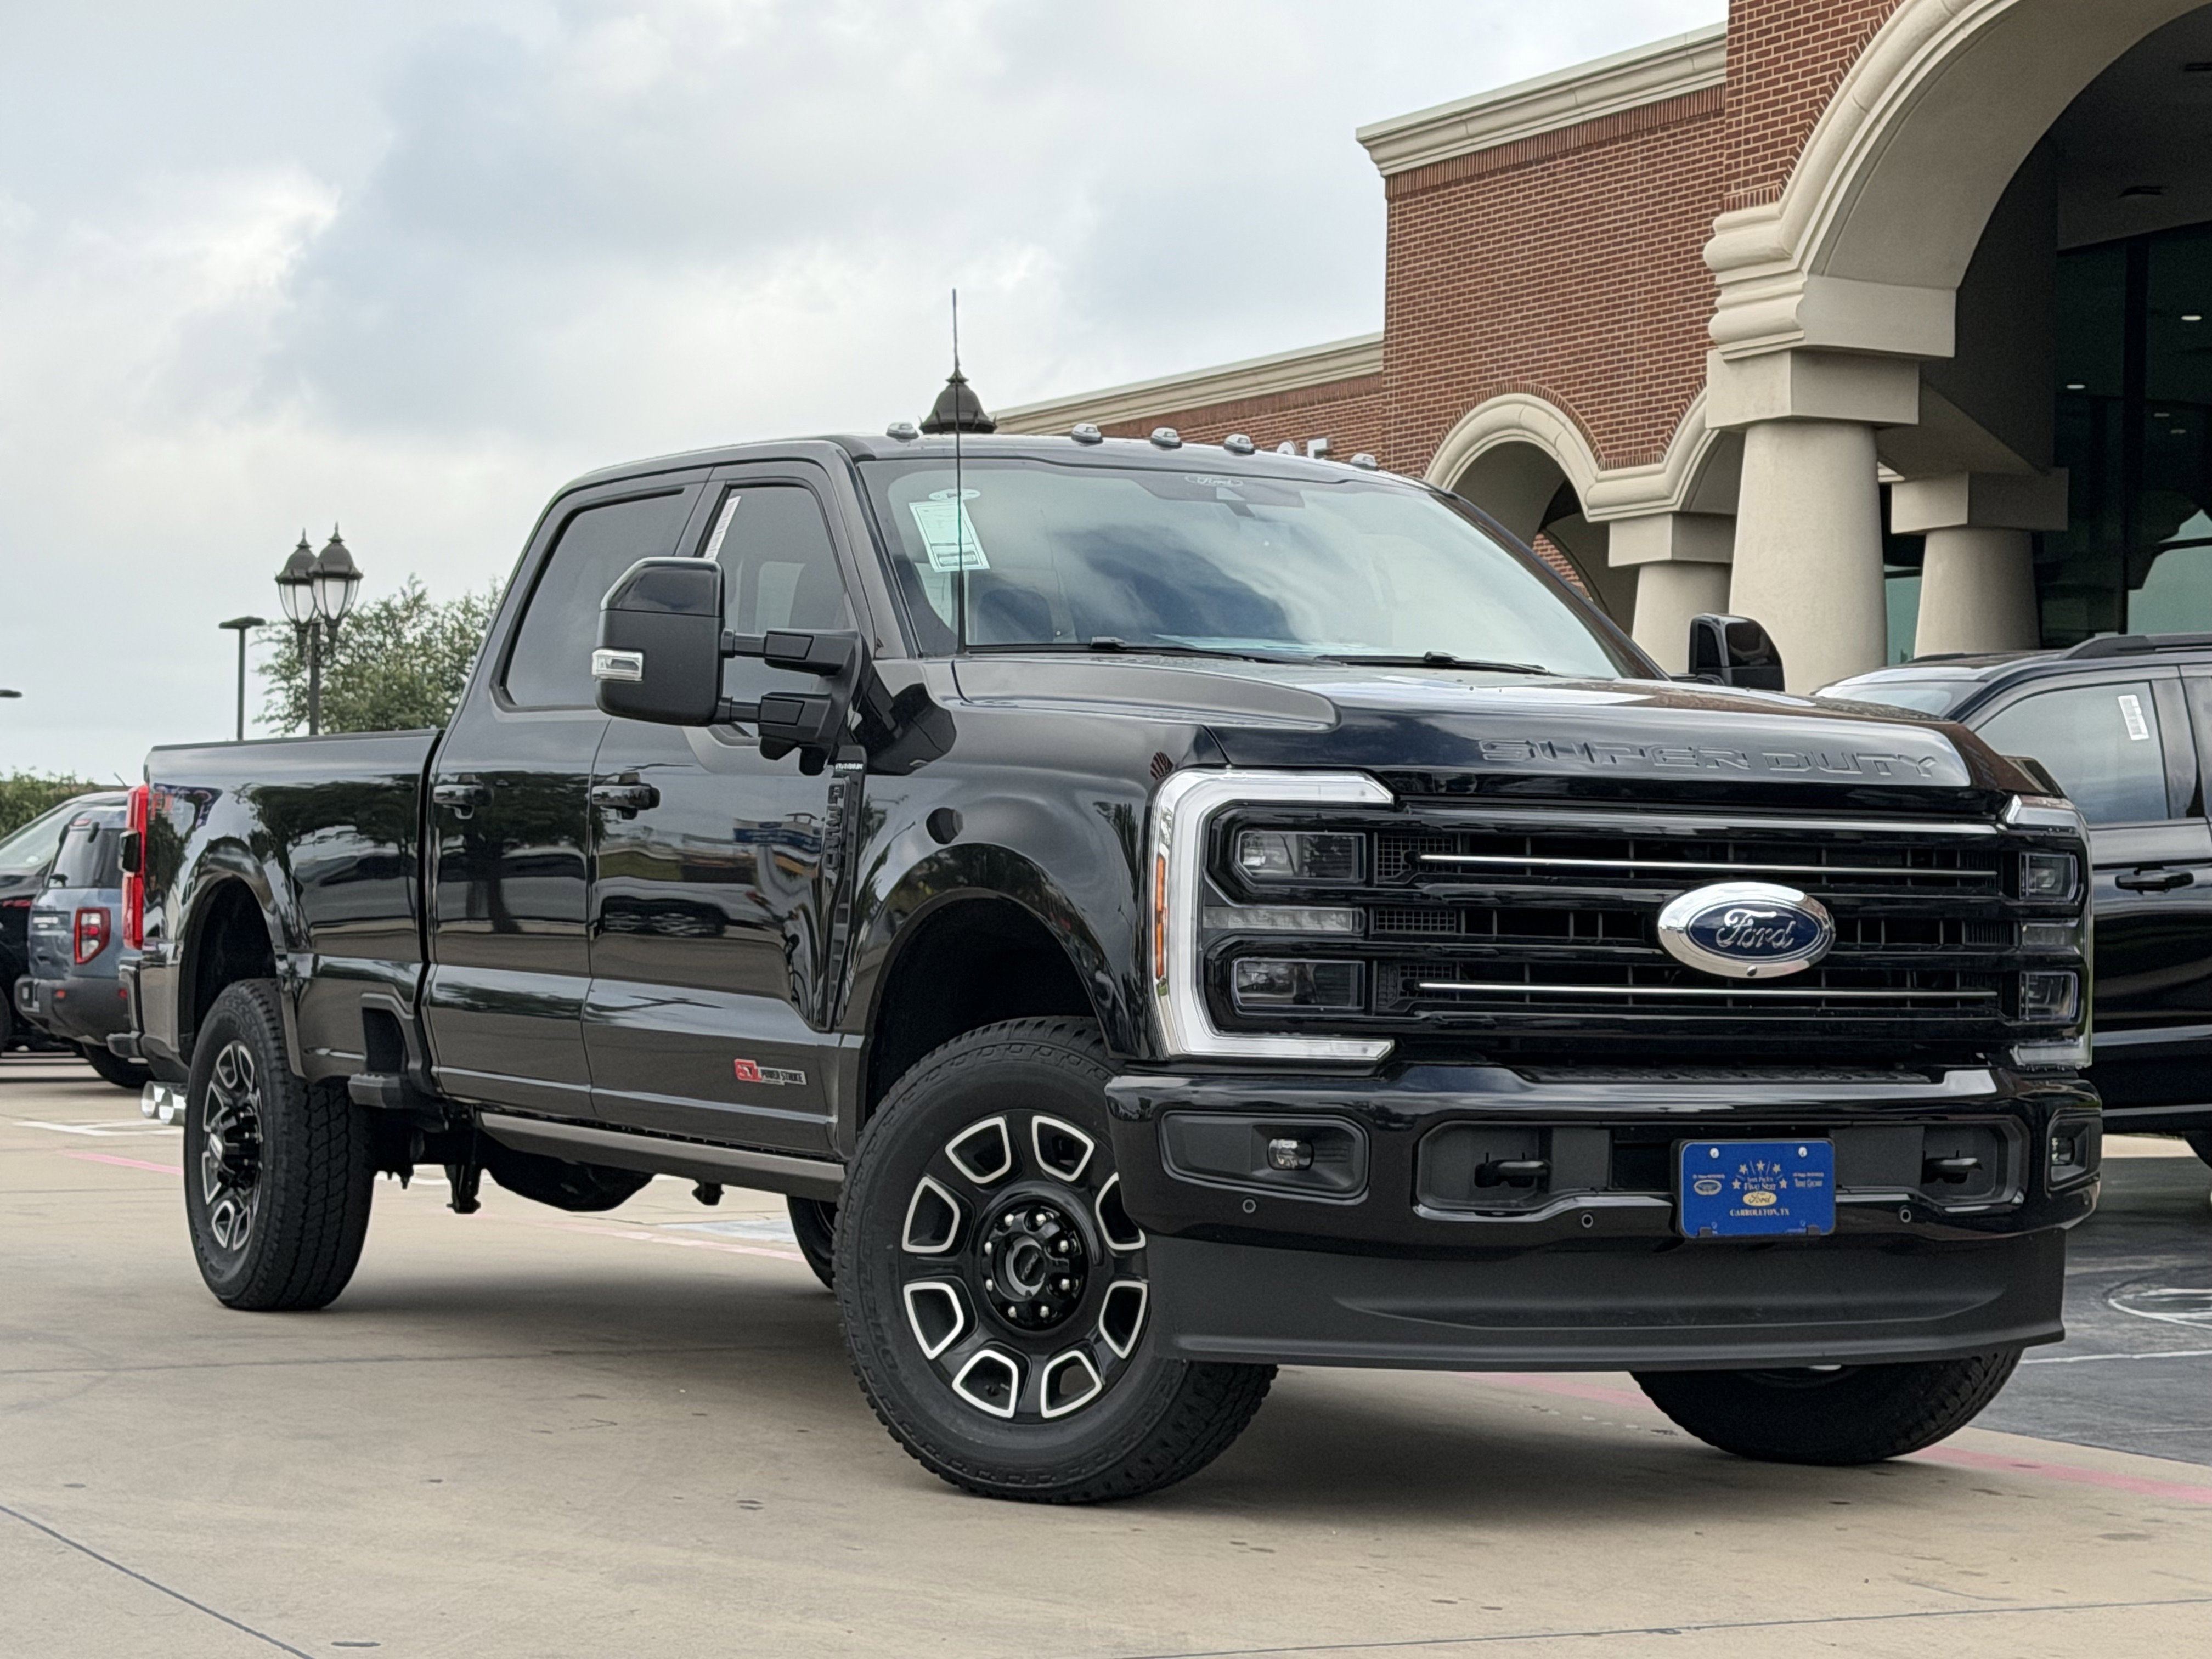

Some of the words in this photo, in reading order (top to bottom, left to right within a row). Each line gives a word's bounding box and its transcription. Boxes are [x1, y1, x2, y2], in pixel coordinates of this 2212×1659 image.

[1478, 738, 1751, 770] SUPER
[1762, 751, 1937, 778] DUTY
[1716, 909, 1796, 948] Ford
[1748, 1192, 1771, 1203] Ford
